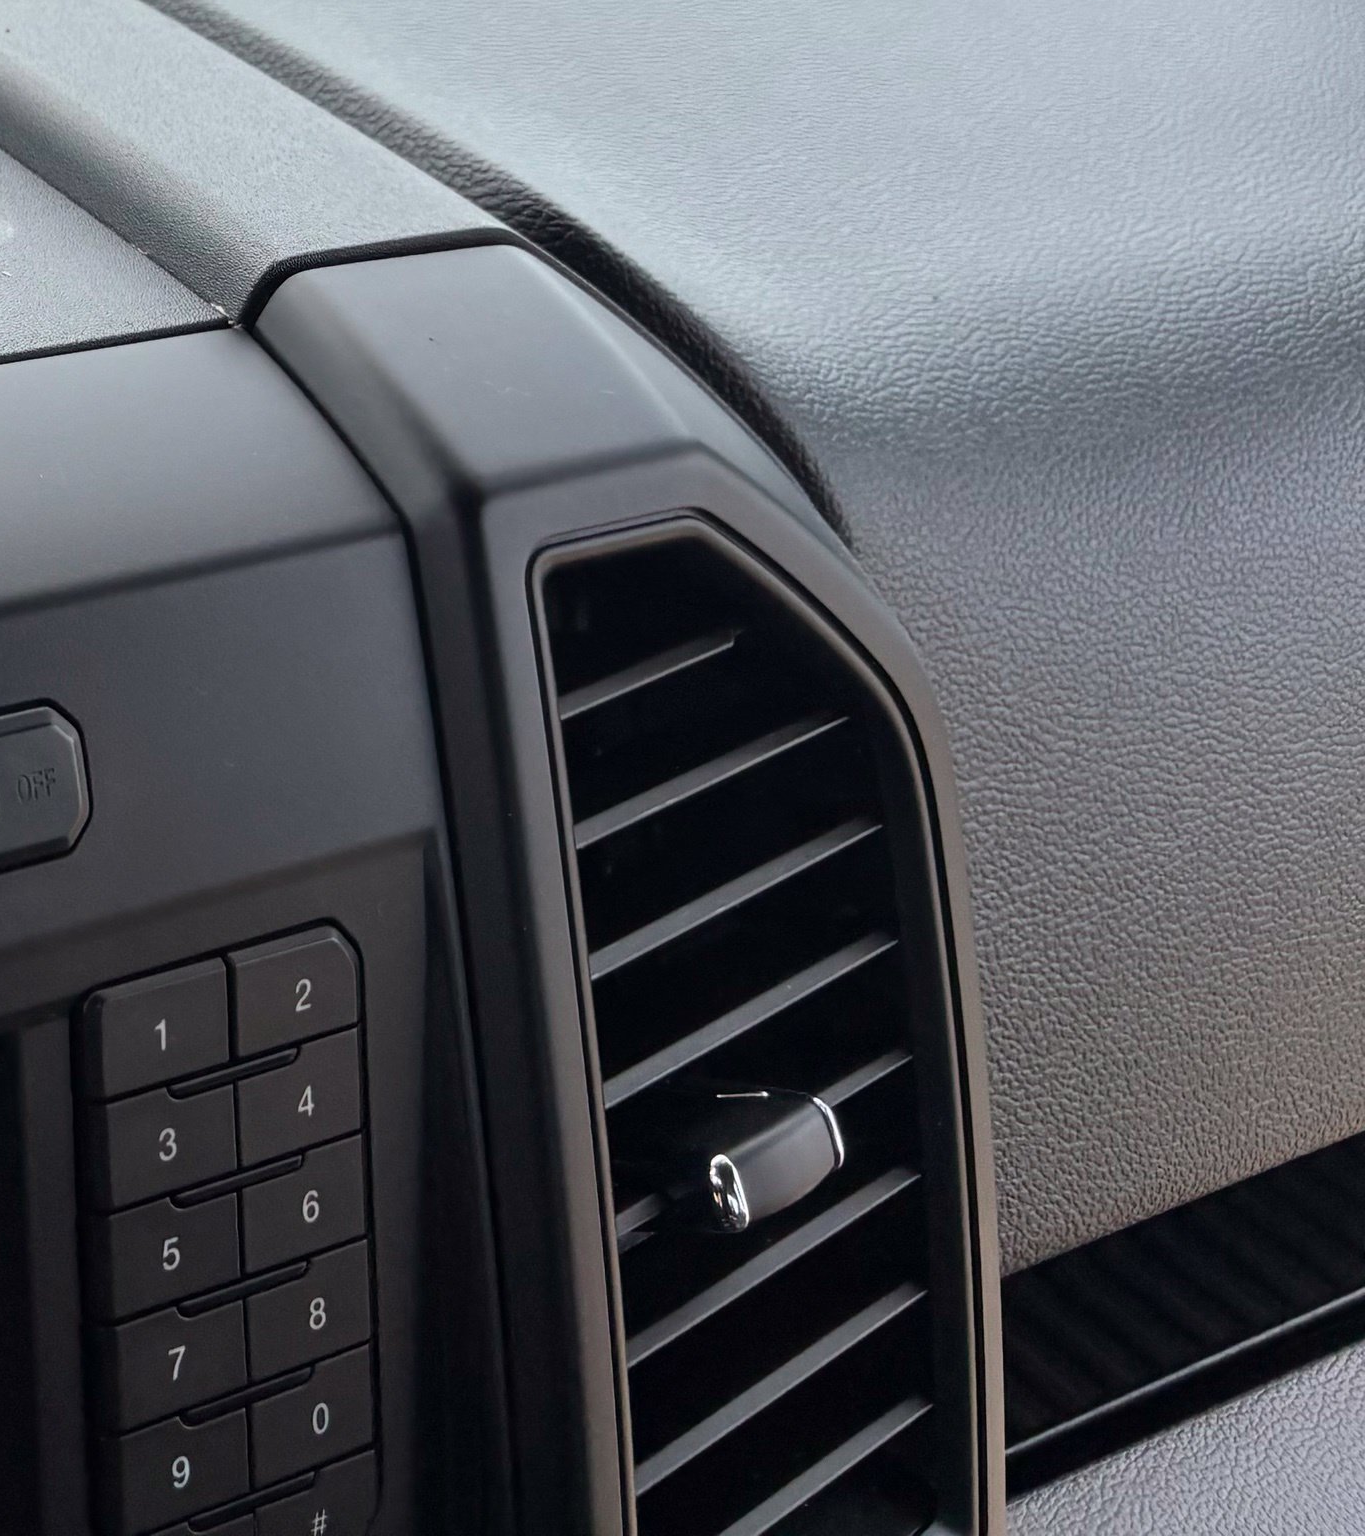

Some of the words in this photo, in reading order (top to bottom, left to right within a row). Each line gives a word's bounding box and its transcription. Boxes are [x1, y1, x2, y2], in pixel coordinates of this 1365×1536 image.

[17, 767, 57, 802] OFF
[295, 978, 313, 1012] 2
[154, 1018, 169, 1051] 1
[297, 1085, 315, 1117] 4
[158, 1127, 178, 1162] 3
[302, 1190, 320, 1223] 6
[162, 1237, 181, 1272] 5
[308, 1297, 327, 1331] 8
[168, 1345, 186, 1381] 7
[311, 1402, 330, 1435] 0
[171, 1455, 190, 1489] 9
[311, 1507, 328, 1536] #
